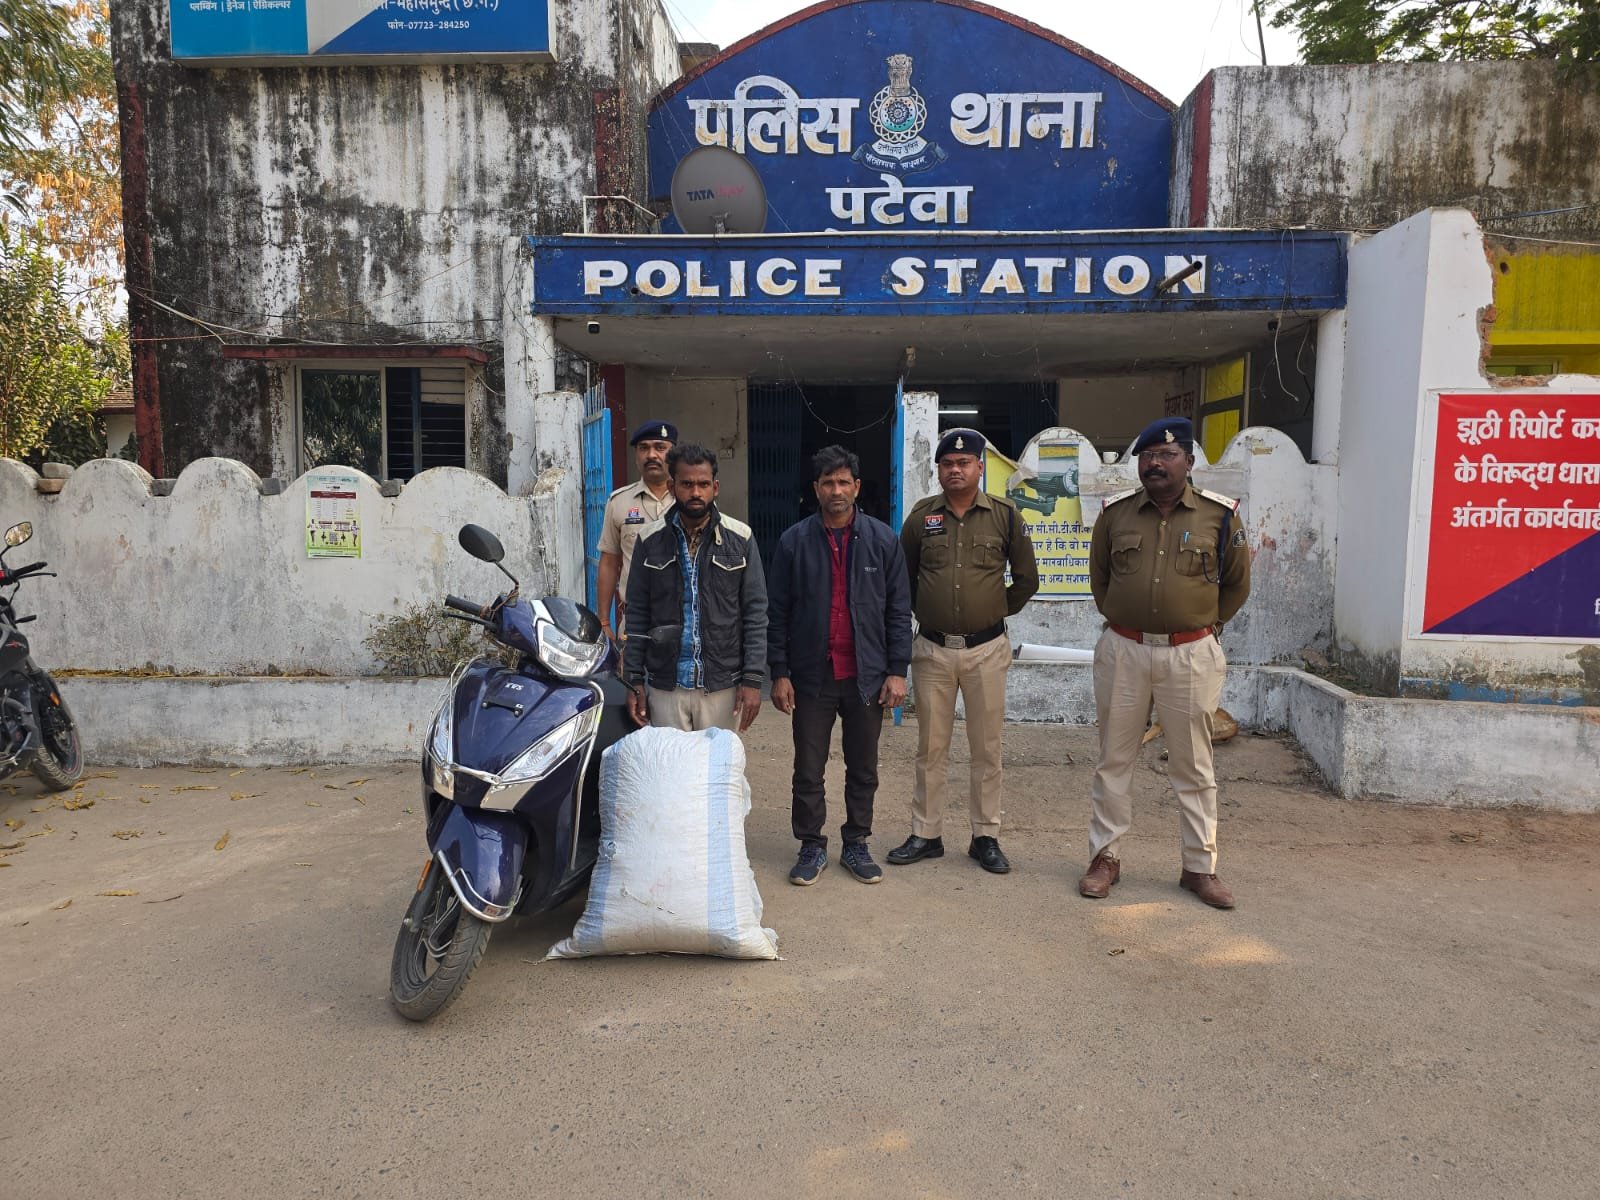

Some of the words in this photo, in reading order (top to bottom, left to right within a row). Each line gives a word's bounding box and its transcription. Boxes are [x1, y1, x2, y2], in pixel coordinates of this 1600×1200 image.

[950, 92, 1102, 149] थाना
[686, 189, 715, 201] TATA
[825, 173, 974, 225] पटेवा
[583, 257, 842, 297] POLICE
[890, 254, 1207, 296] STATION
[1456, 409, 1503, 445] झूठी
[1508, 408, 1566, 440] रिपोर्ट
[1453, 454, 1478, 484] के
[1450, 498, 1522, 528] अंतर्गत
